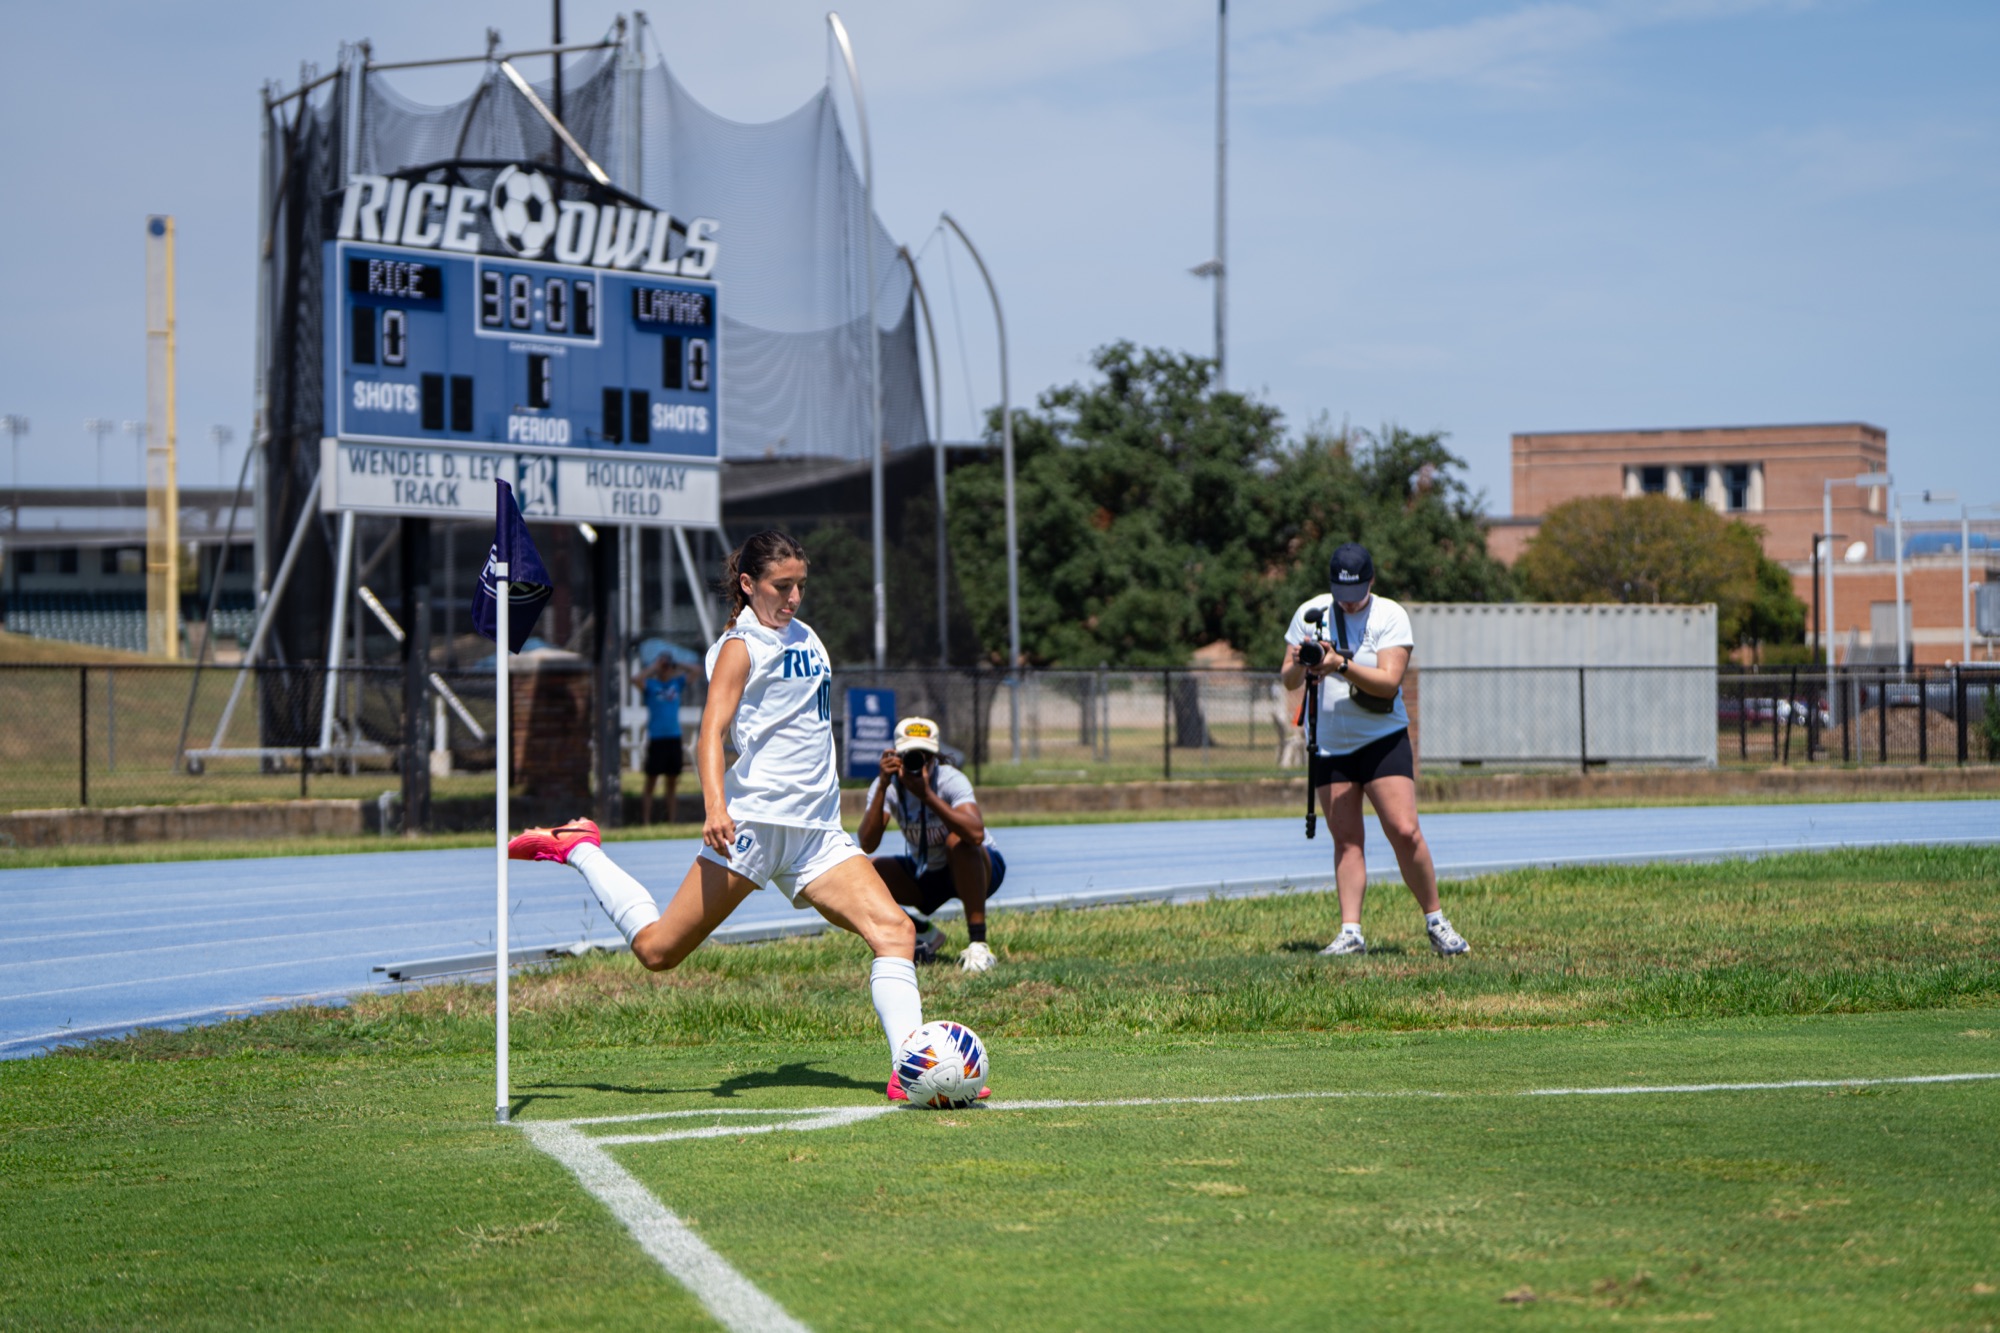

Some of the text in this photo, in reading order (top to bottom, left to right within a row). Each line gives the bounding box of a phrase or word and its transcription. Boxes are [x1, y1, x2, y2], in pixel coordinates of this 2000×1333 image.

[337, 174, 720, 277] RICE OWLS
[369, 259, 424, 298] RICE
[483, 271, 595, 331] 38:07
[638, 288, 705, 325] LAMAR
[383, 310, 405, 363] 0
[688, 338, 708, 388] 0
[353, 380, 419, 413] SHOTS
[508, 416, 570, 445] PERIOD
[651, 403, 709, 433] SHOTS
[348, 448, 502, 481] WENDEL D. LEY
[586, 463, 687, 491] HOLLOWAY
[392, 479, 459, 506] TRACK
[612, 492, 660, 516] FIELD
[817, 680, 830, 721] 10
